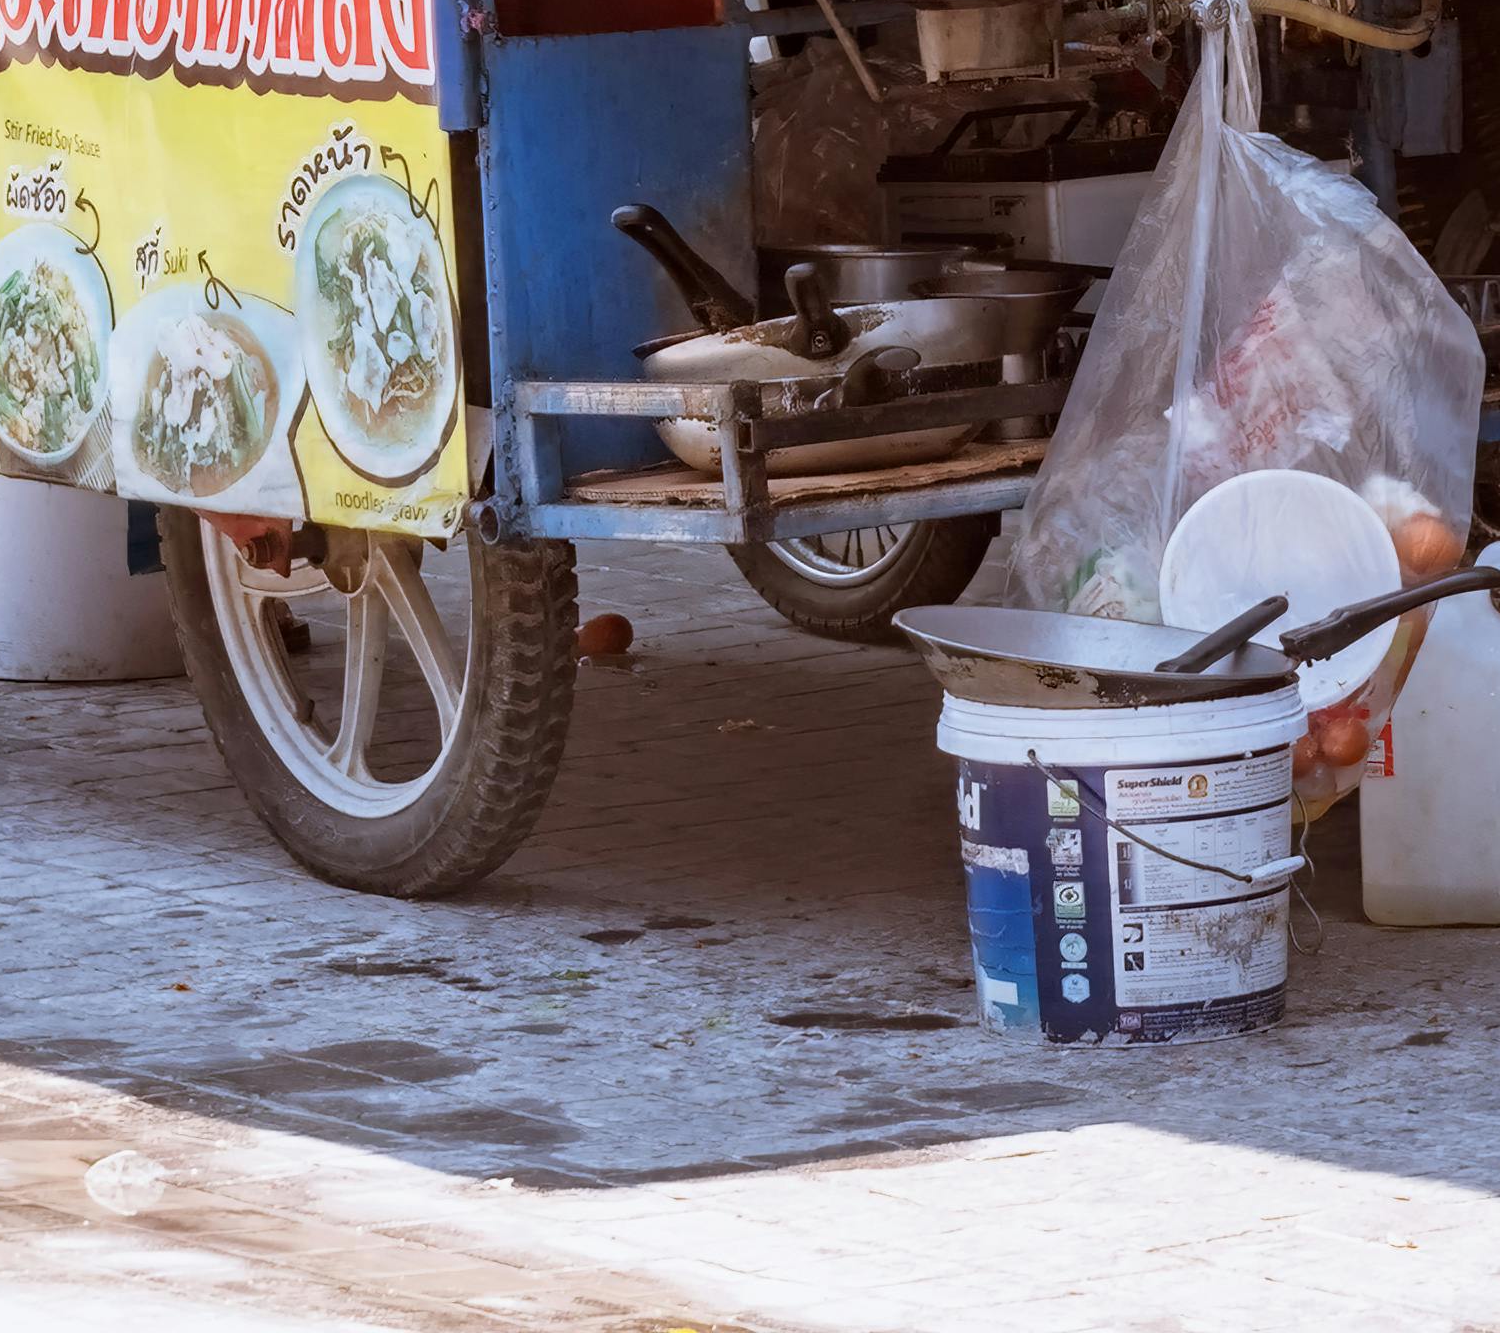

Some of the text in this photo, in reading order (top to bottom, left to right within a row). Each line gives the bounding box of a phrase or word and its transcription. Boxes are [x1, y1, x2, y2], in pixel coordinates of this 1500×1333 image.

[4, 118, 22, 141] Stir
[25, 120, 53, 147] Fried
[55, 128, 73, 155] Soy
[278, 125, 371, 250] ราดหน้า
[163, 245, 188, 275] Suki
